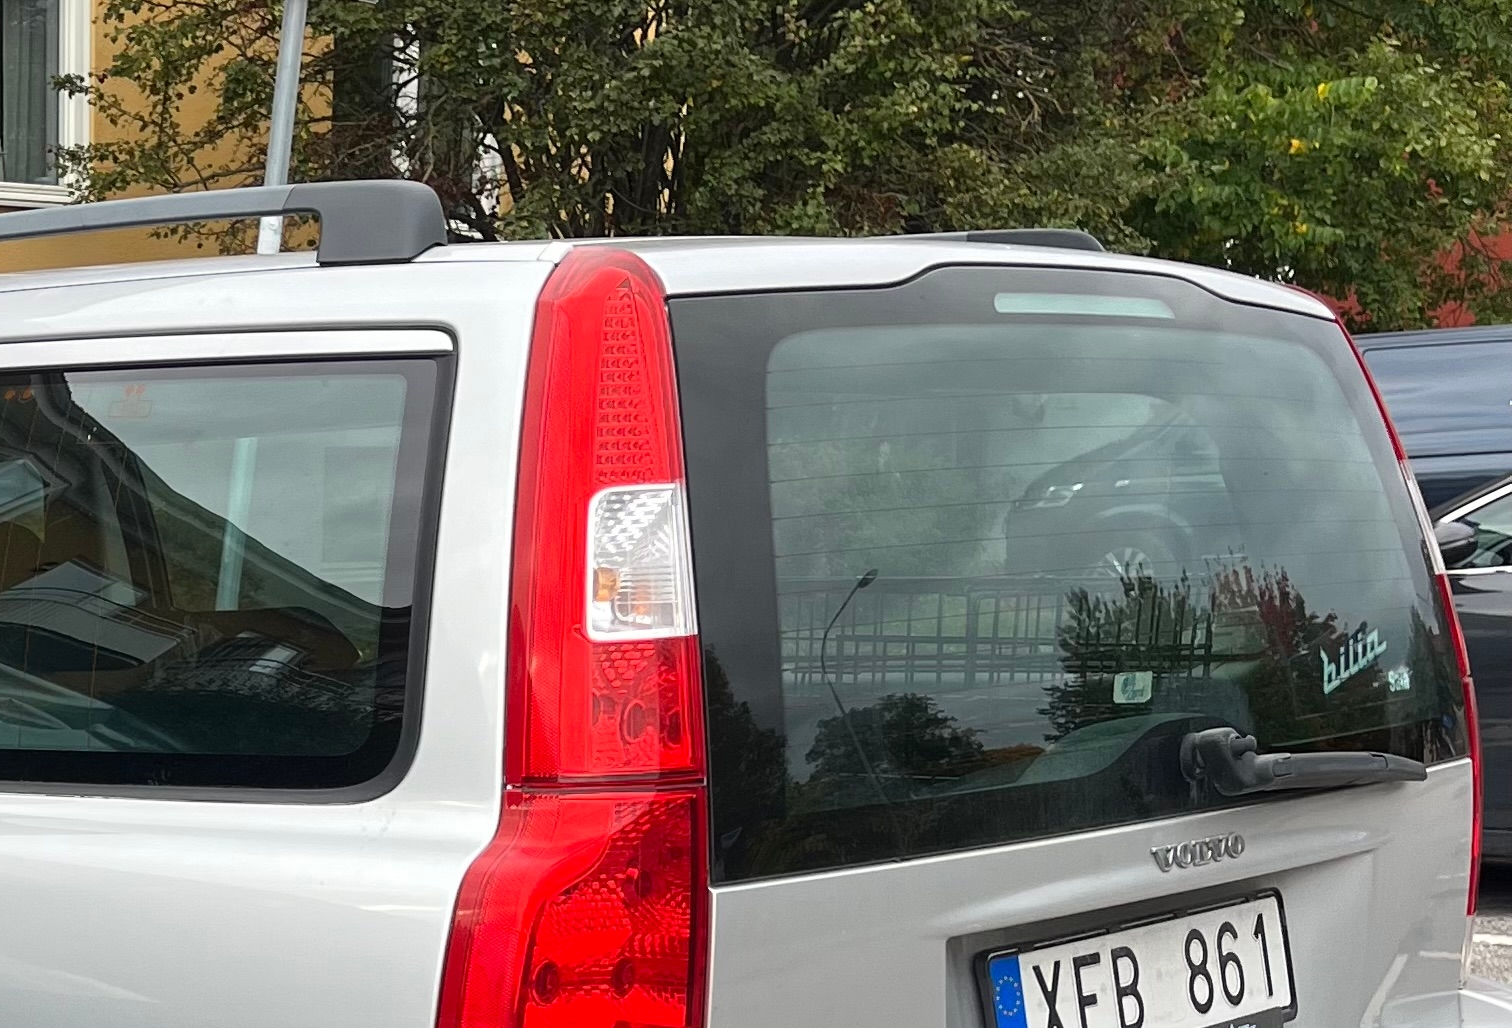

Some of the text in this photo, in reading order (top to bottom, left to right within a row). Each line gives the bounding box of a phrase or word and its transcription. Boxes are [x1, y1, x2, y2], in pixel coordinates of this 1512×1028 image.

[1319, 628, 1388, 694] bilia
[1151, 833, 1245, 872] VOLVO
[1184, 912, 1275, 1015] 861
